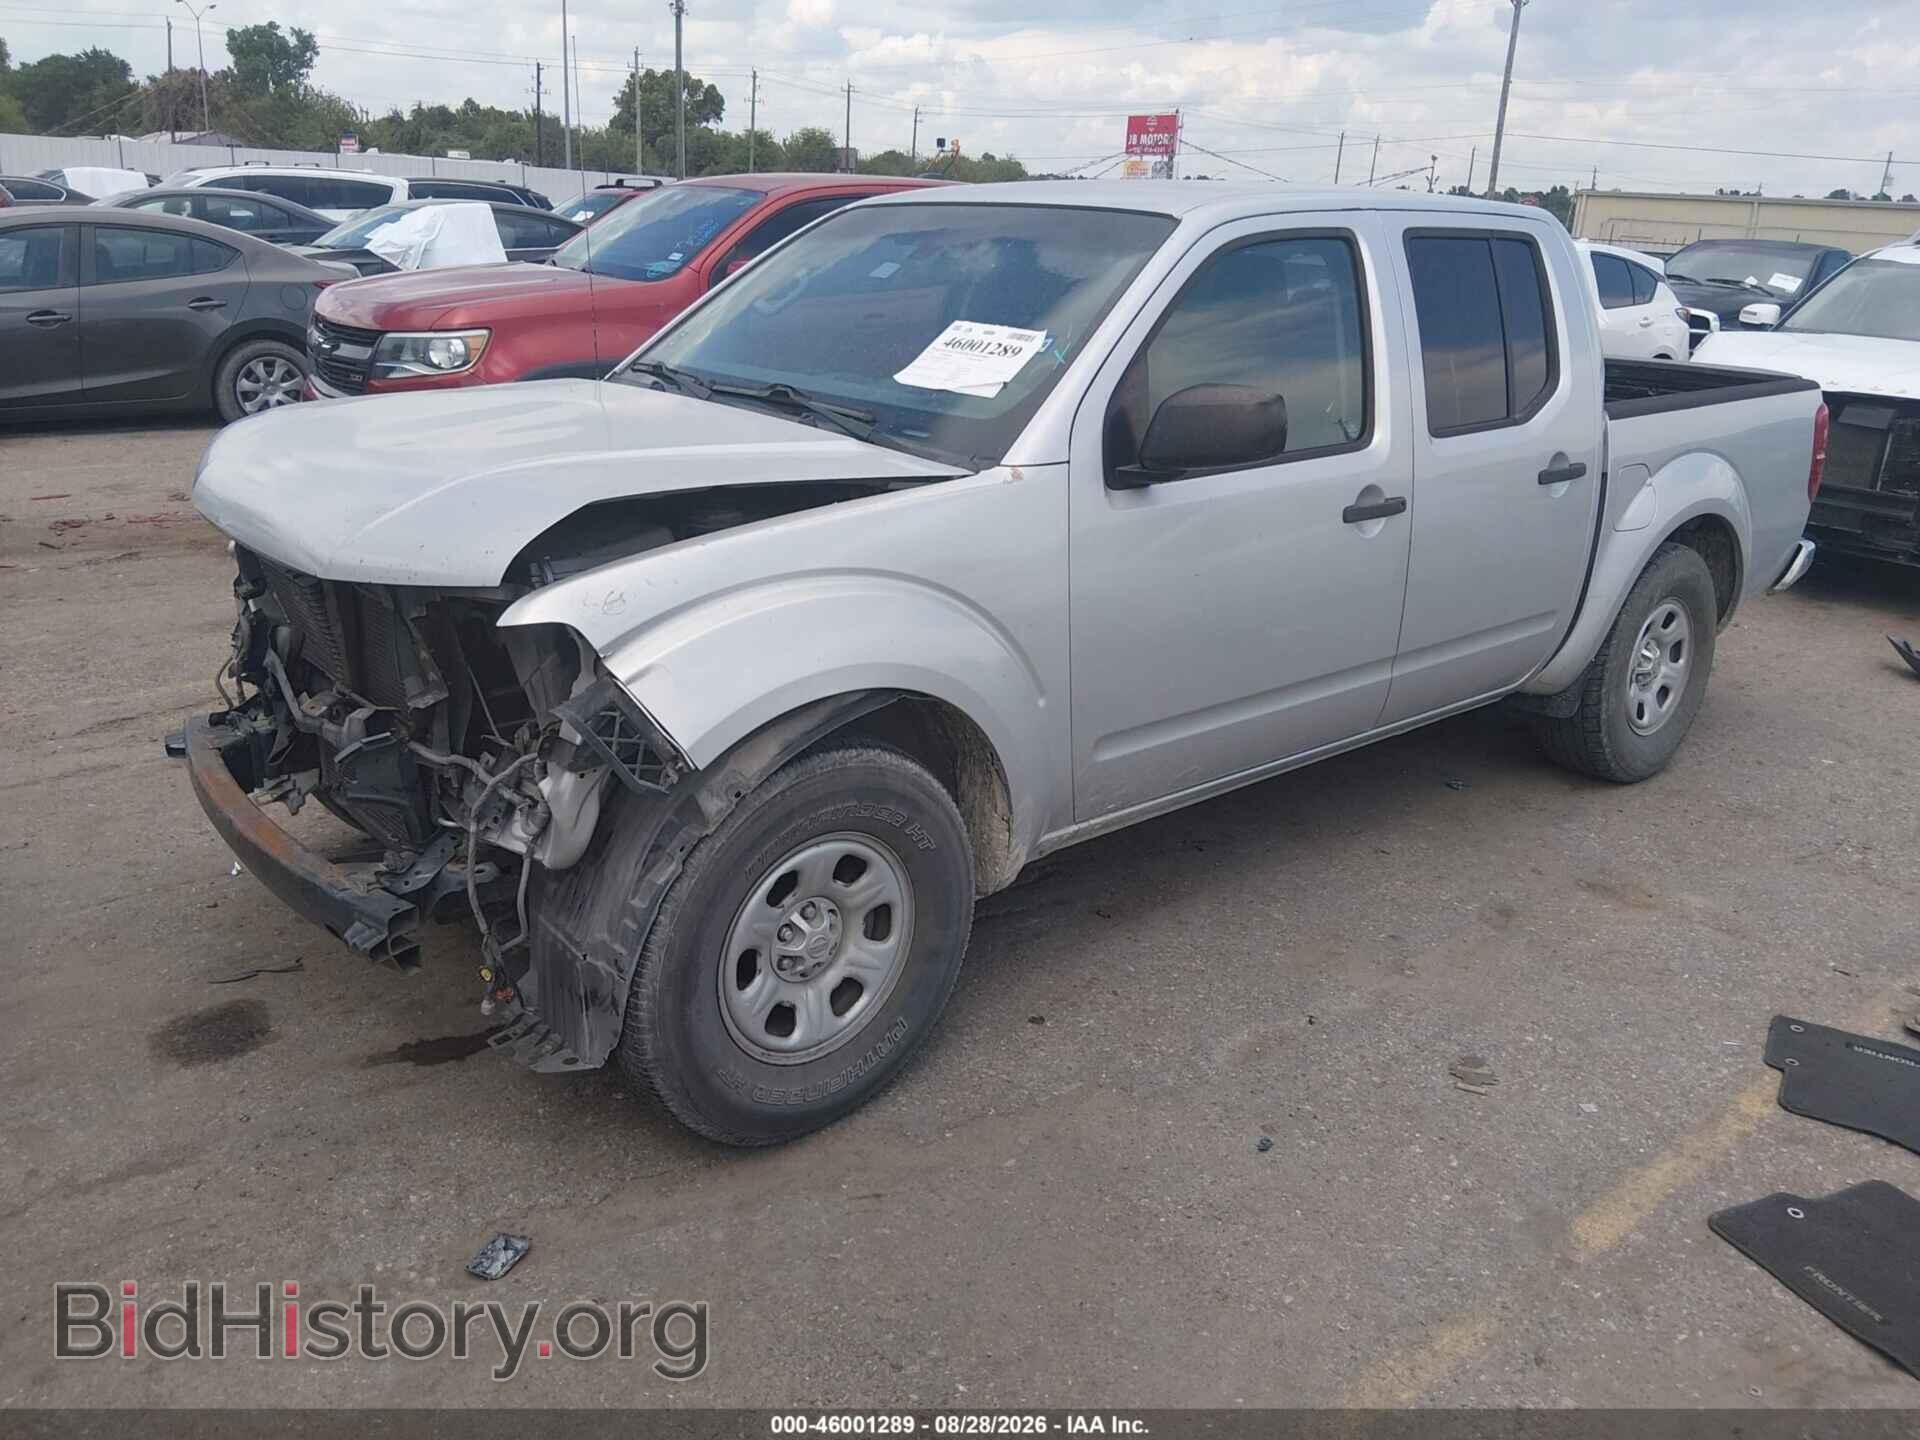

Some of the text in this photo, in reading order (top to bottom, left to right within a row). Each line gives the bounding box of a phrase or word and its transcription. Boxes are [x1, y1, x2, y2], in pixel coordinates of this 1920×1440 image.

[943, 336, 1023, 358] 46001289
[904, 823, 937, 851] HT
[1852, 1045, 1920, 1067] RONTIER
[1803, 1265, 1882, 1322] FRONTIER
